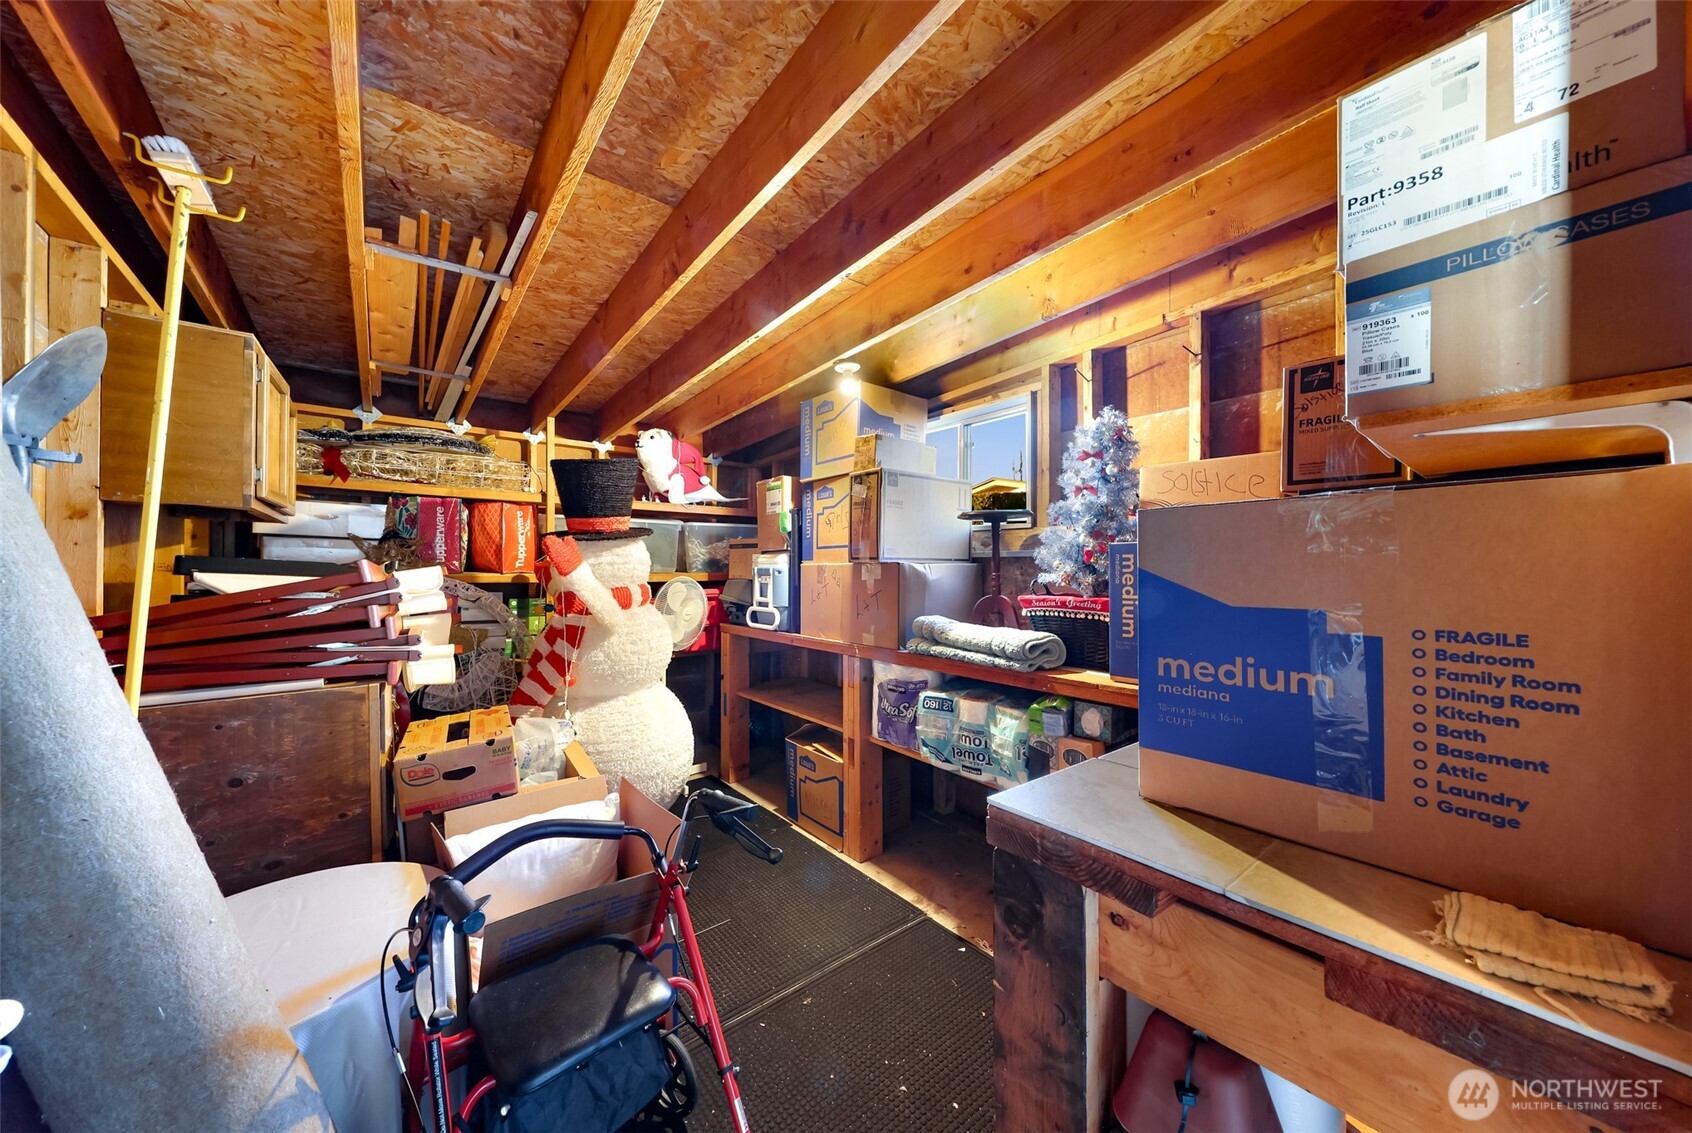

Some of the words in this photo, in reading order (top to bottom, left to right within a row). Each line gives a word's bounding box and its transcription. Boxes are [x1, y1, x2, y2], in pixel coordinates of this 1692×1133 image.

[1557, 83, 1580, 101] 72
[1524, 101, 1535, 113] 4
[1347, 166, 1445, 211] Part:9358
[1347, 204, 1381, 218] Revision:
[1362, 316, 1397, 331] 919363
[1416, 309, 1430, 317] 100
[1361, 328, 1380, 336] Pillow
[1381, 324, 1400, 332] Cases
[803, 406, 811, 456] medium
[1299, 413, 1344, 429] FRAGIL
[1299, 427, 1319, 435] MIXED
[805, 489, 813, 539] medium
[435, 506, 445, 563] upperware
[515, 510, 527, 568] Tupperware
[1121, 553, 1139, 638] medium
[1434, 629, 1530, 648] FRAGILE
[1435, 648, 1535, 669] Bedroom
[1157, 656, 1337, 699] medium
[1435, 667, 1507, 689] Family
[1511, 674, 1582, 695] Room
[1157, 683, 1231, 703] mediana
[1435, 686, 1505, 709] Dining
[1510, 694, 1580, 716] Room
[899, 702, 918, 724] Sof
[923, 699, 939, 709] 160
[1158, 702, 1179, 714] 18-in
[1219, 712, 1244, 725] 16-in
[1435, 705, 1520, 729] Kitchen
[1436, 723, 1487, 744] Bath
[491, 745, 512, 755] BABY
[951, 746, 993, 766] Towel
[1436, 742, 1550, 775] Basement
[407, 766, 435, 780] Dole
[788, 748, 796, 798] medium
[1436, 762, 1488, 783] Attic
[1436, 780, 1530, 813] Laundry
[1436, 800, 1522, 829] Garage
